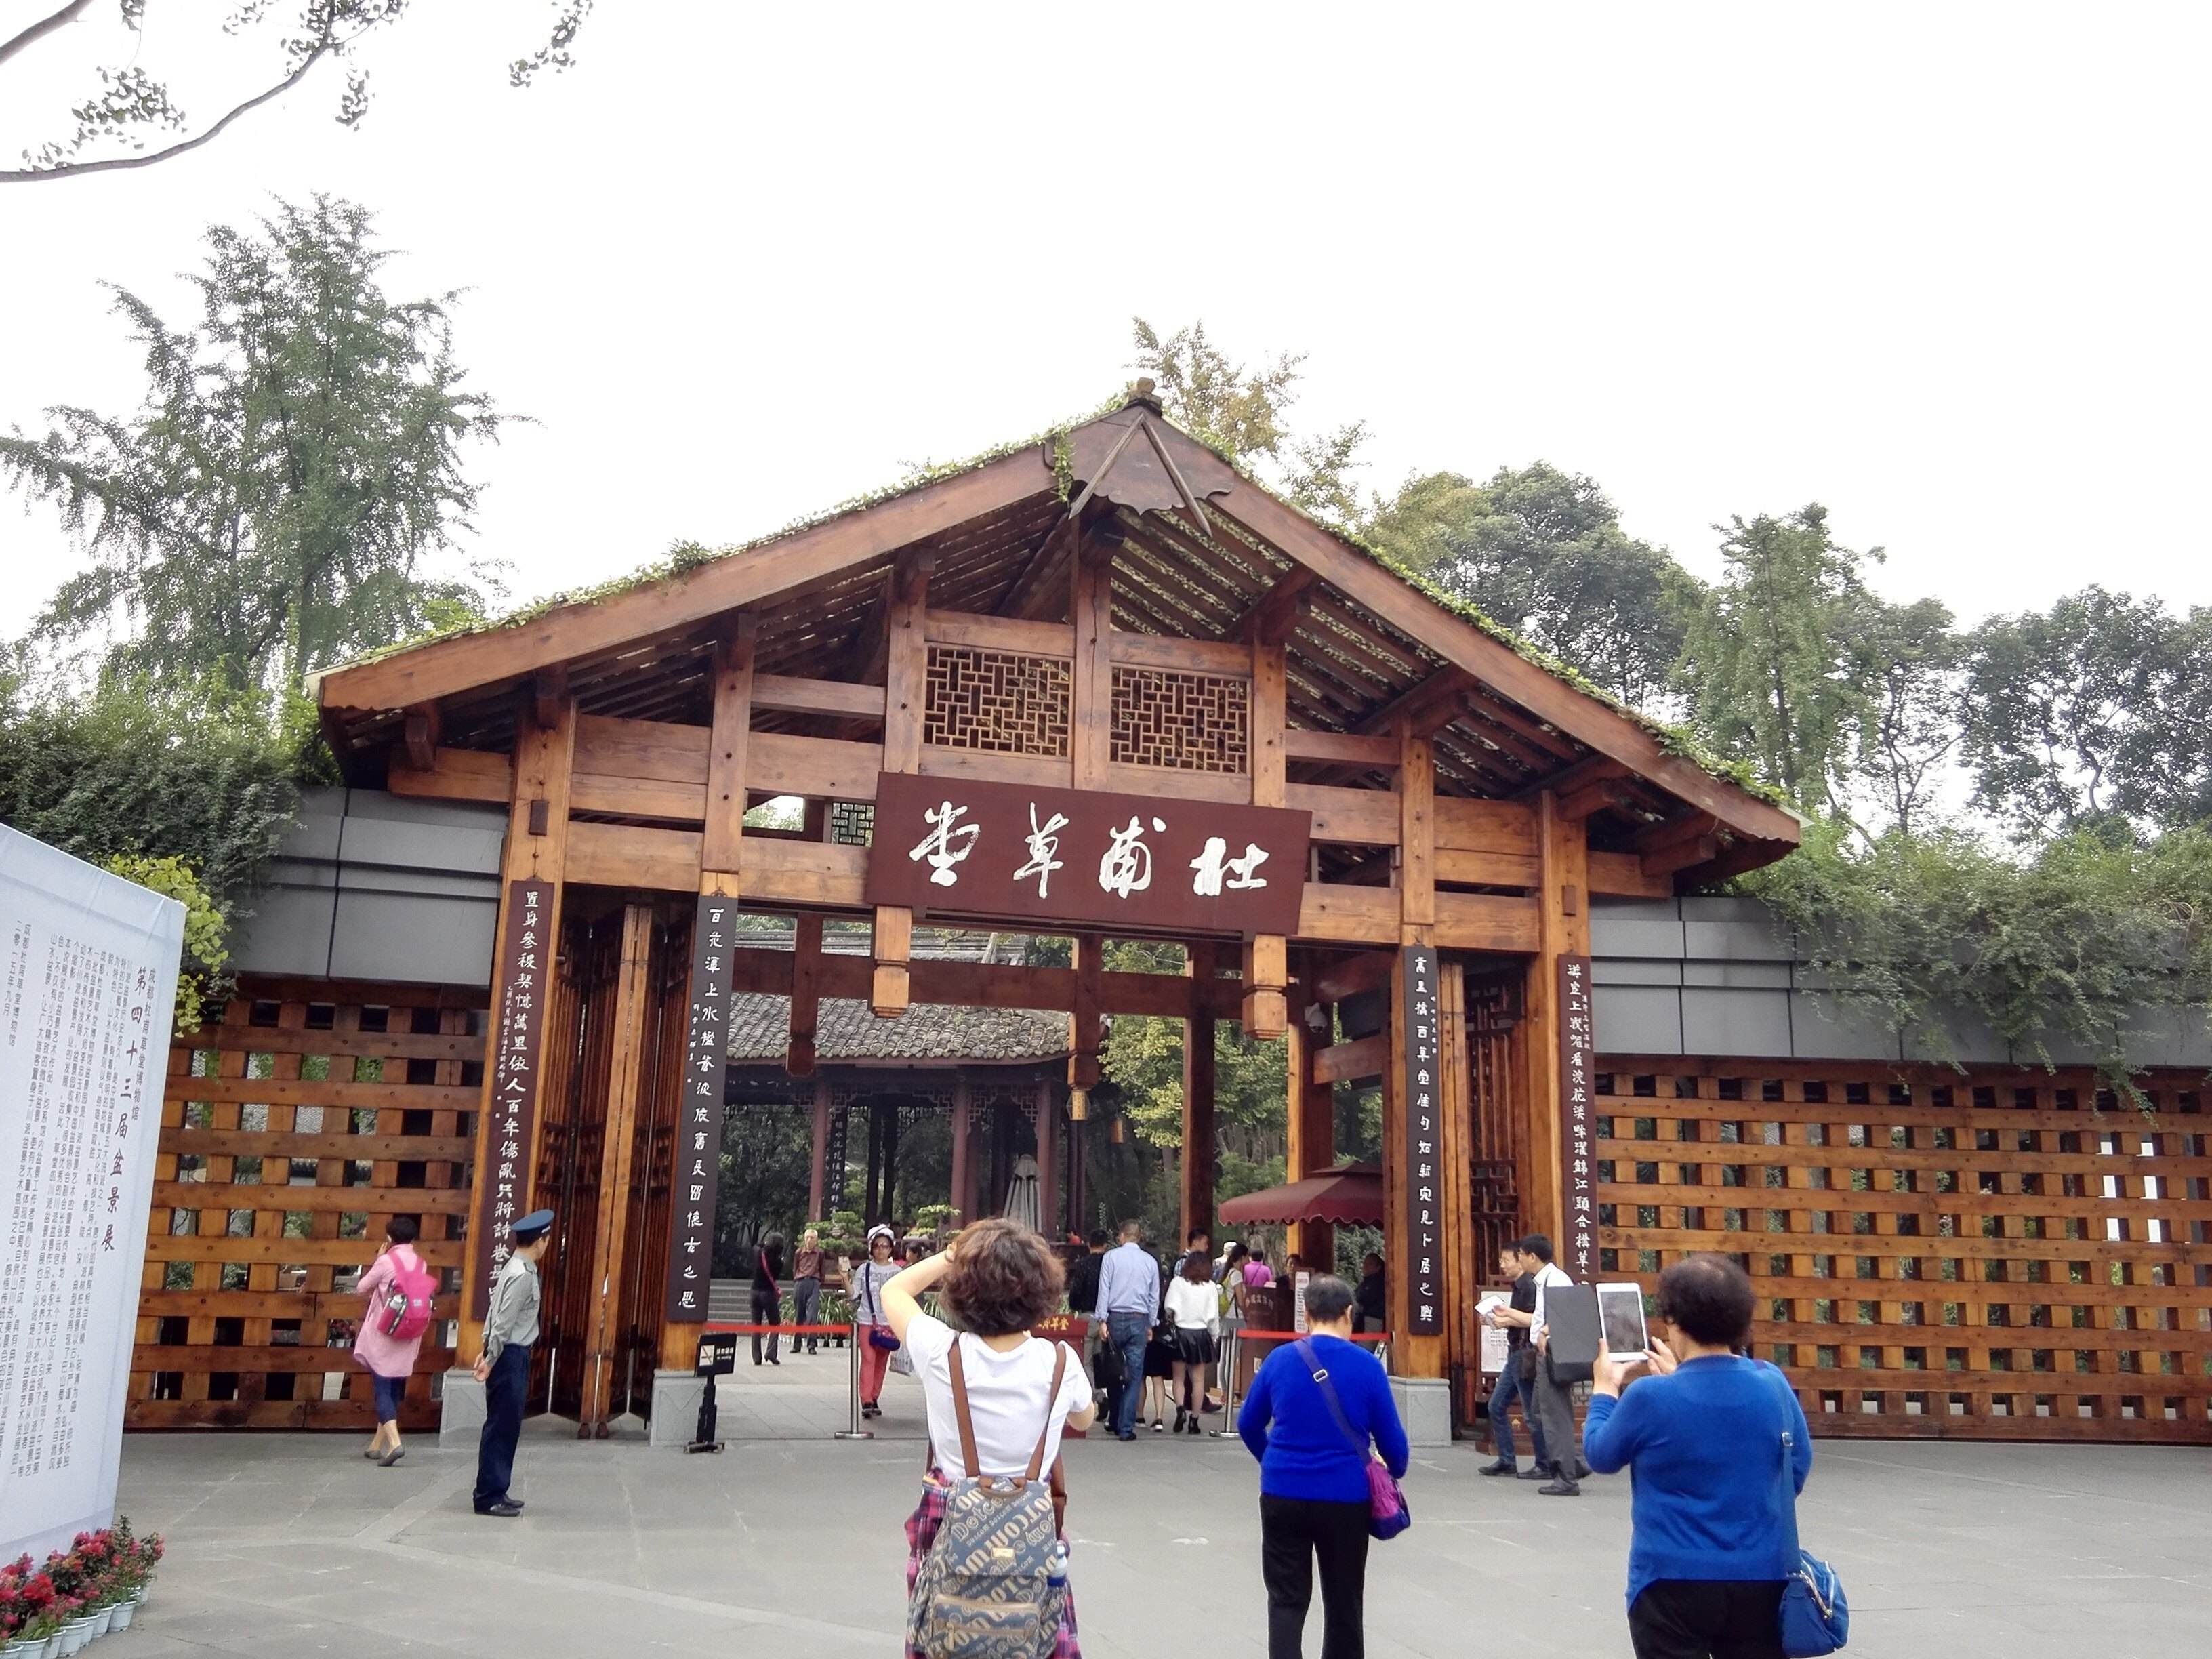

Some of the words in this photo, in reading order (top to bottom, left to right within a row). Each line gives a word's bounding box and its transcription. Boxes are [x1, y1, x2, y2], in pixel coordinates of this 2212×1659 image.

[907, 800, 1269, 899] 杜甫草堂
[100, 966, 147, 1252] 第四十三届盆景展
